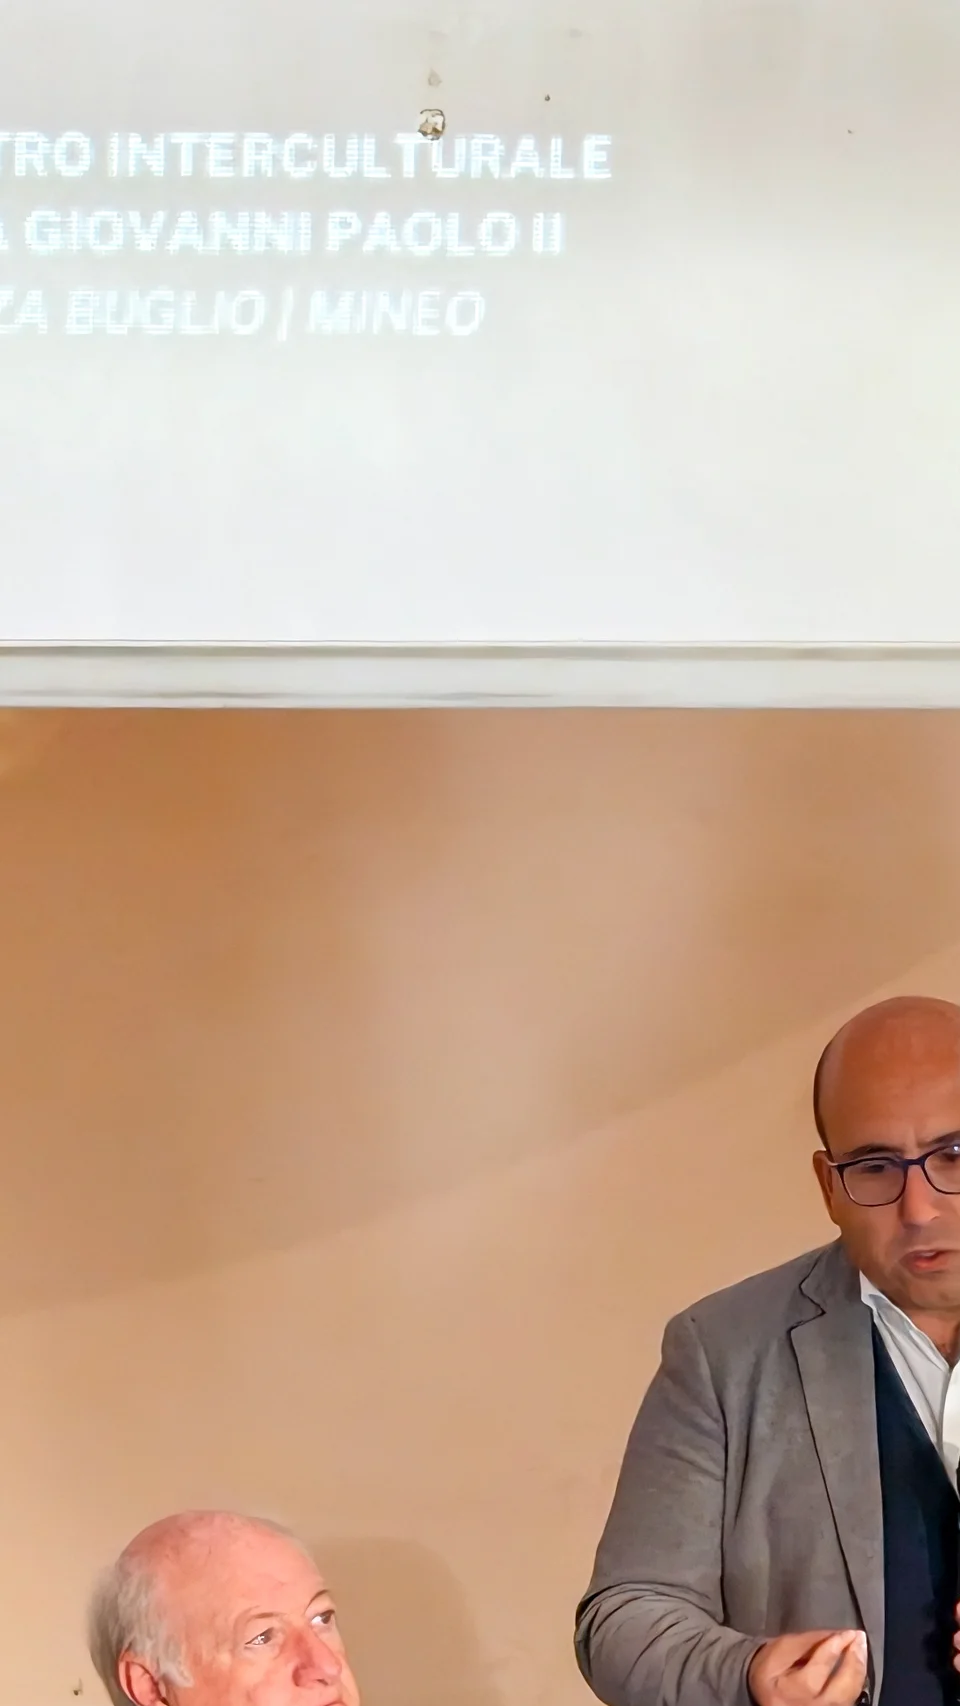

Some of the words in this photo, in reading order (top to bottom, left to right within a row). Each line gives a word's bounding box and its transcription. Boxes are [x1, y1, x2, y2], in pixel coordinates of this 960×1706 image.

[109, 132, 613, 180] INTERCULTURALE
[25, 210, 312, 256] GIOVANNI
[328, 211, 517, 257] PAOLO
[532, 213, 566, 257] II
[65, 288, 263, 337] BUGLIO
[305, 290, 487, 337] MINEO
